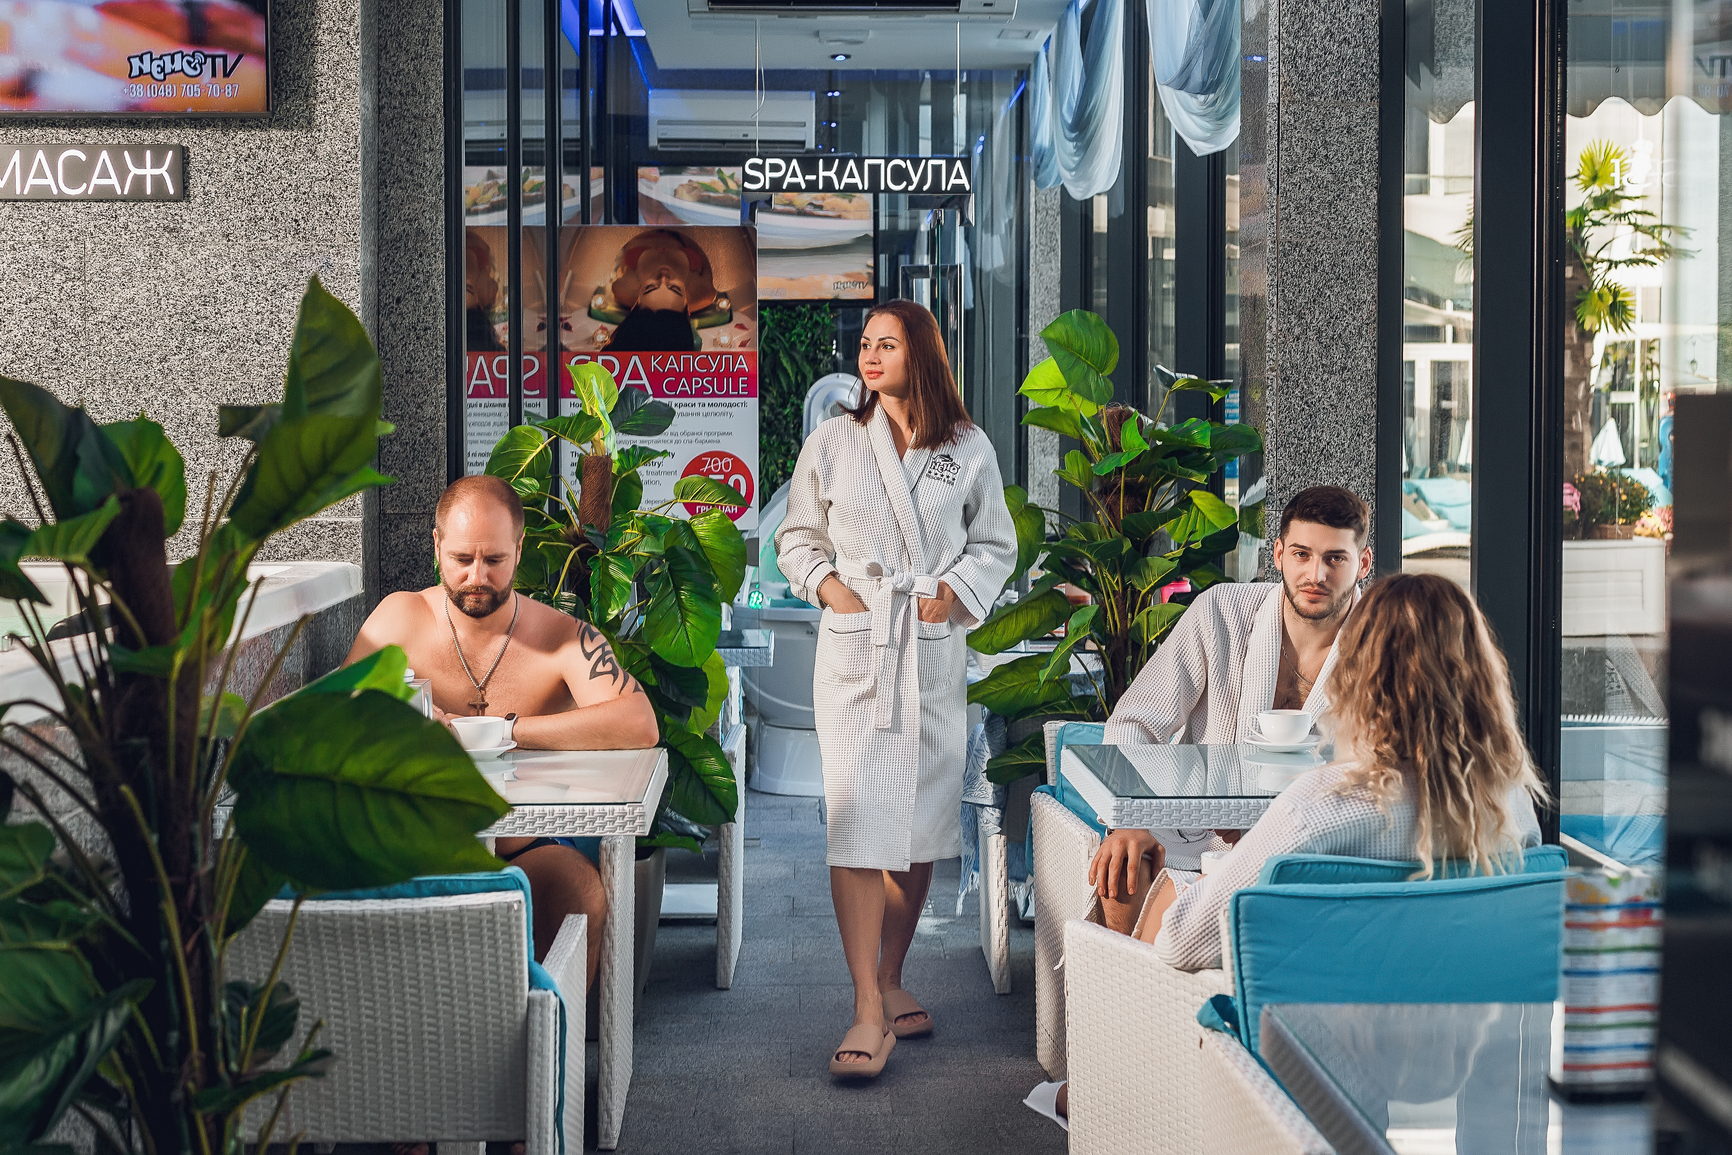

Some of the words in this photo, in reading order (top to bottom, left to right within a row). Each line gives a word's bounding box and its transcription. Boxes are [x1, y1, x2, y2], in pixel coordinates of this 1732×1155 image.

[124, 83, 145, 98] +38
[146, 83, 177, 98] (048)
[743, 157, 971, 192] SPA-КАПСУЛА
[651, 354, 749, 373] КАПСУЛА
[662, 377, 749, 395] CAPSULE
[708, 401, 748, 409] молодості:
[702, 457, 734, 473] 700
